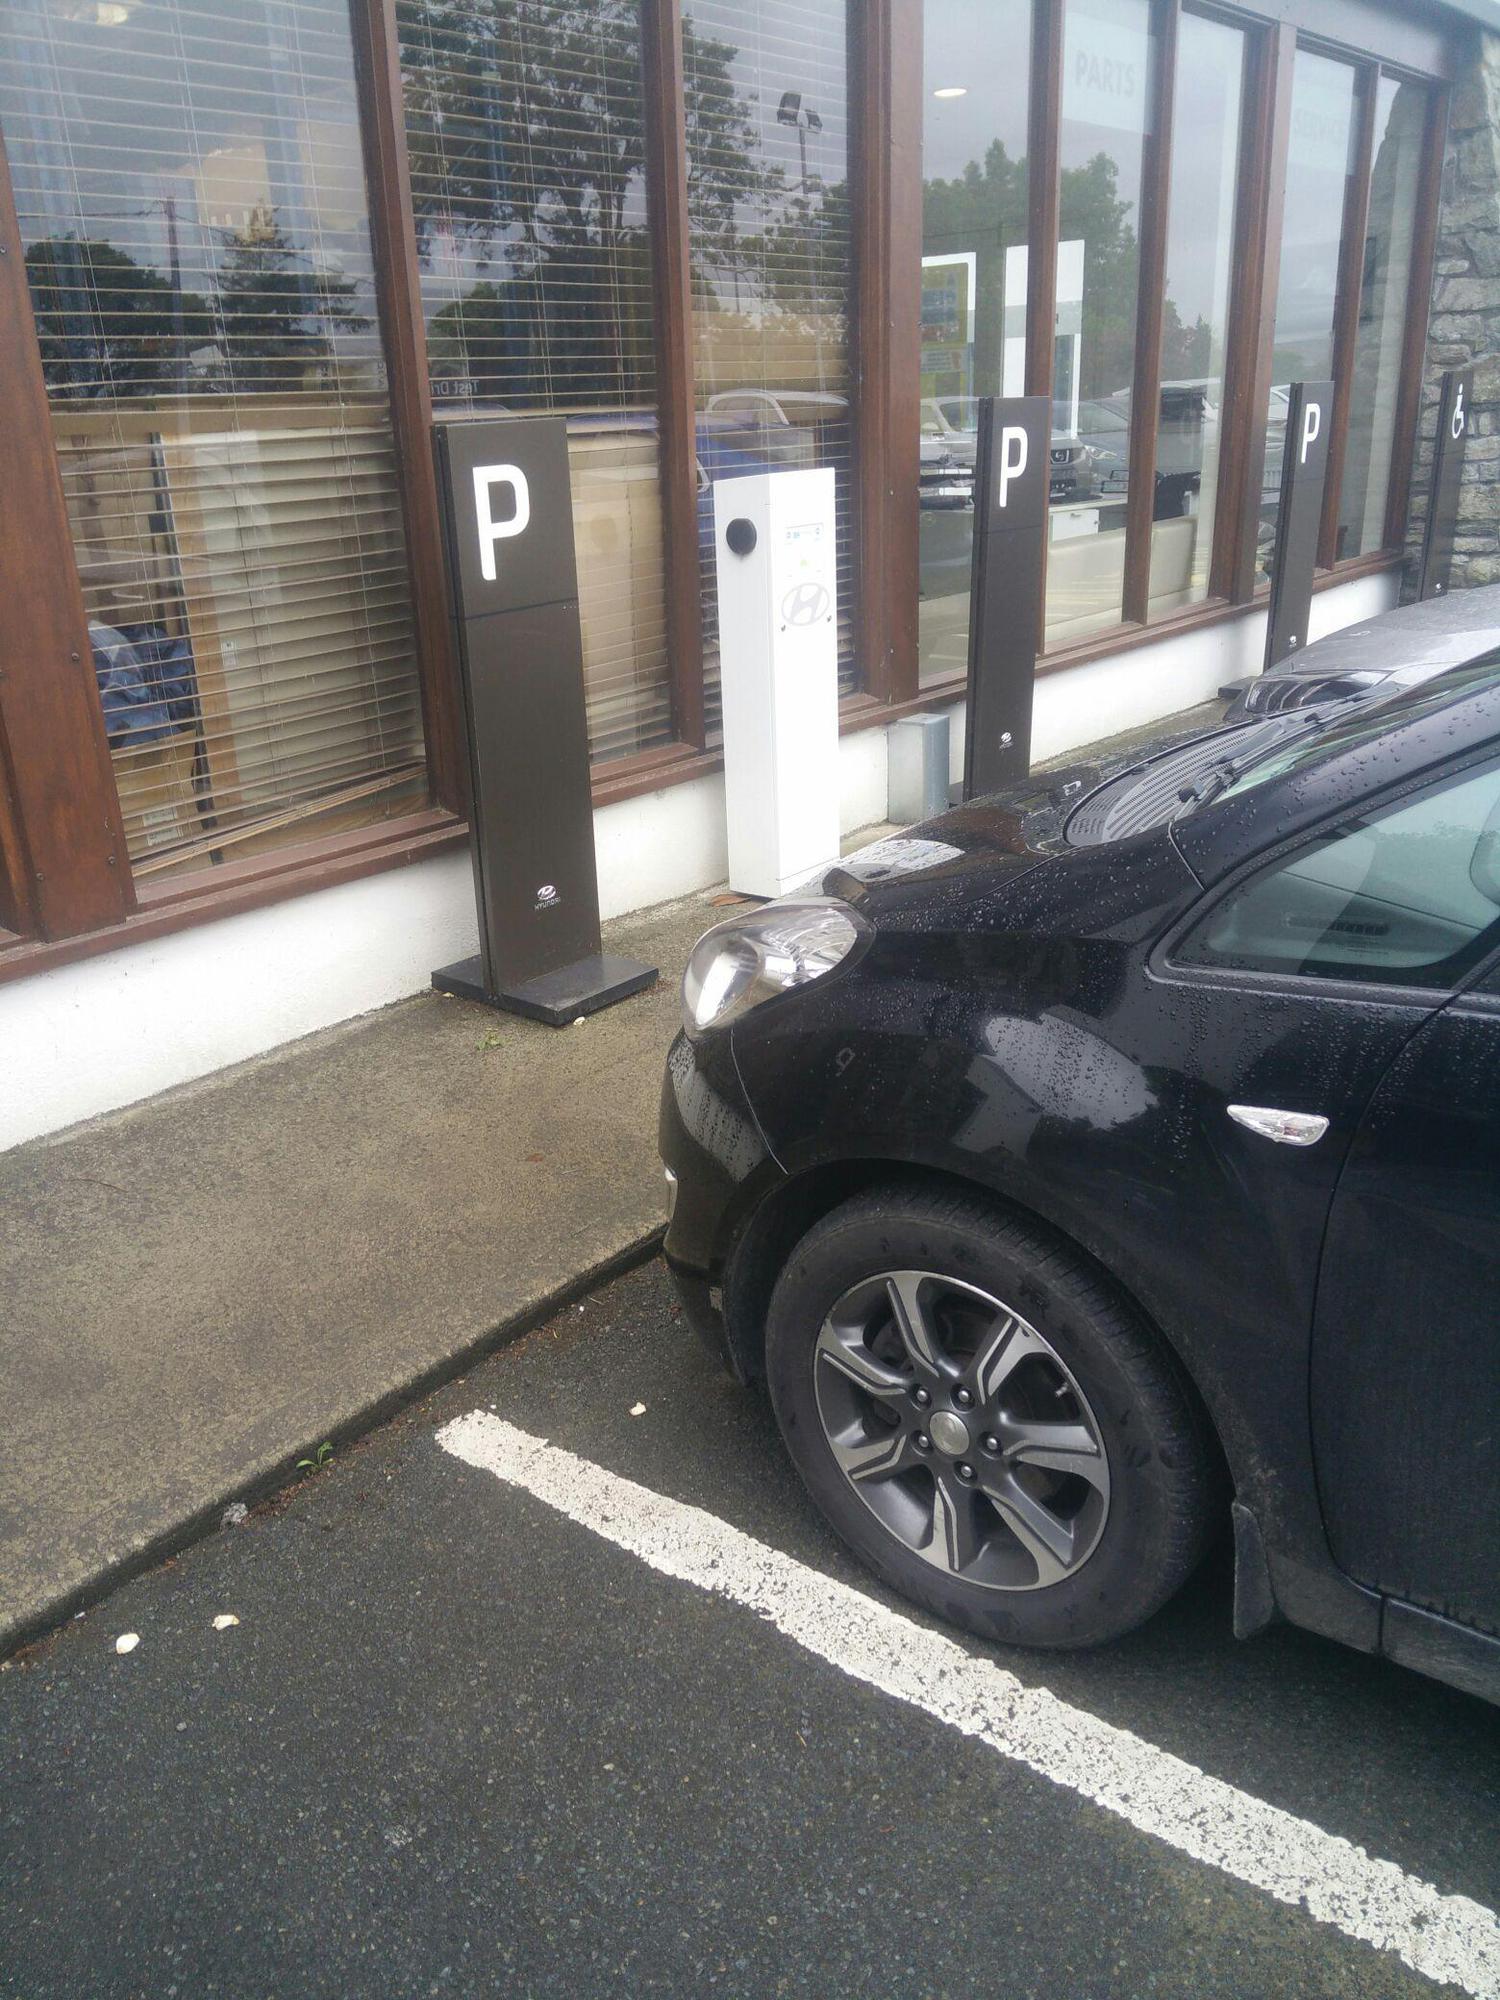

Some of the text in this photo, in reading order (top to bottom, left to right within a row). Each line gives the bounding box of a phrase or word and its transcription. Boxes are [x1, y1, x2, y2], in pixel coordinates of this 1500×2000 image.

[1075, 51, 1136, 98] PARTS
[999, 426, 1029, 508] P
[1301, 402, 1321, 464] P
[472, 463, 531, 581] P
